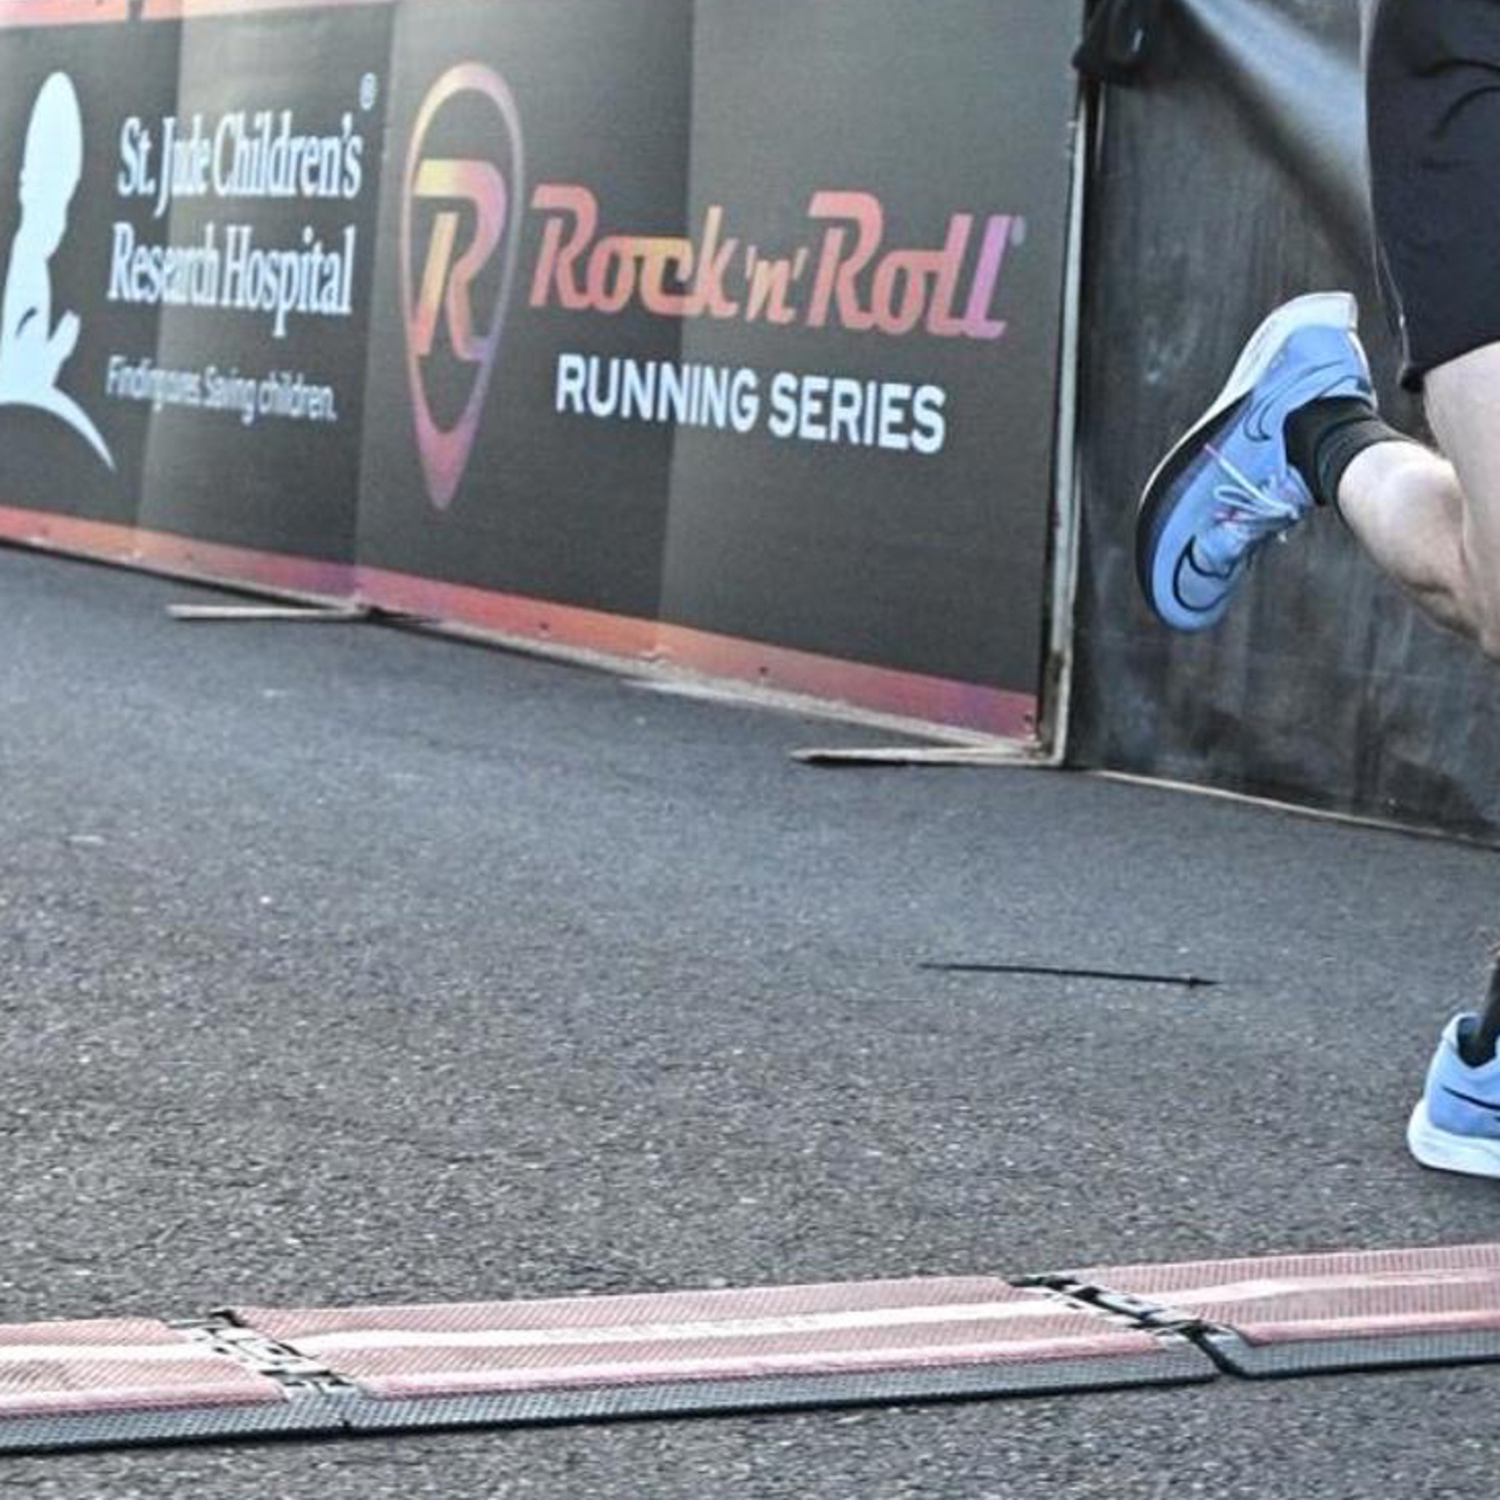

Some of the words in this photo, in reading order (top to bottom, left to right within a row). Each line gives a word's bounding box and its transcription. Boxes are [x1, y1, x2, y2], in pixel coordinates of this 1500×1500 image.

[117, 116, 155, 197] St.
[212, 110, 364, 198] Children's
[221, 225, 356, 337] Hospital
[556, 353, 758, 433] RUNNING
[768, 373, 946, 454] SERIES
